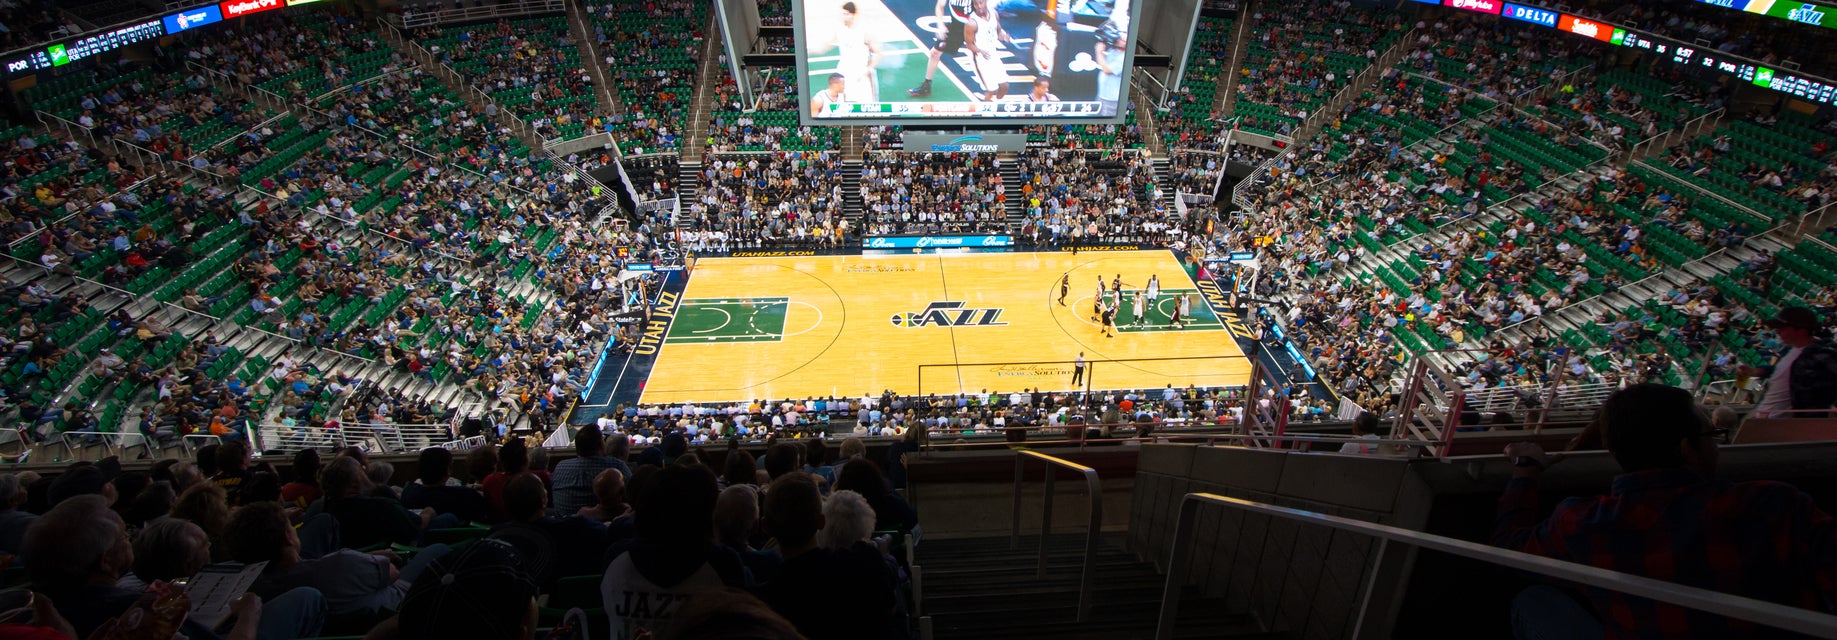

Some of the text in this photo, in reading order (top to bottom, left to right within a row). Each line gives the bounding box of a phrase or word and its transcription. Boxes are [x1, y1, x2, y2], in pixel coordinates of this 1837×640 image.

[227, 1, 260, 15] KeyBank
[1516, 7, 1555, 25] DELTA
[8, 60, 29, 73] POR
[1637, 39, 1651, 49] UTA
[1702, 57, 1714, 67] 32
[1719, 61, 1737, 73] POR
[653, 291, 680, 319] JAZZ
[1197, 280, 1231, 309] UTAH
[891, 301, 1009, 327] JAZZ
[1214, 310, 1256, 339] JAZZ
[635, 320, 668, 355] UTAH
